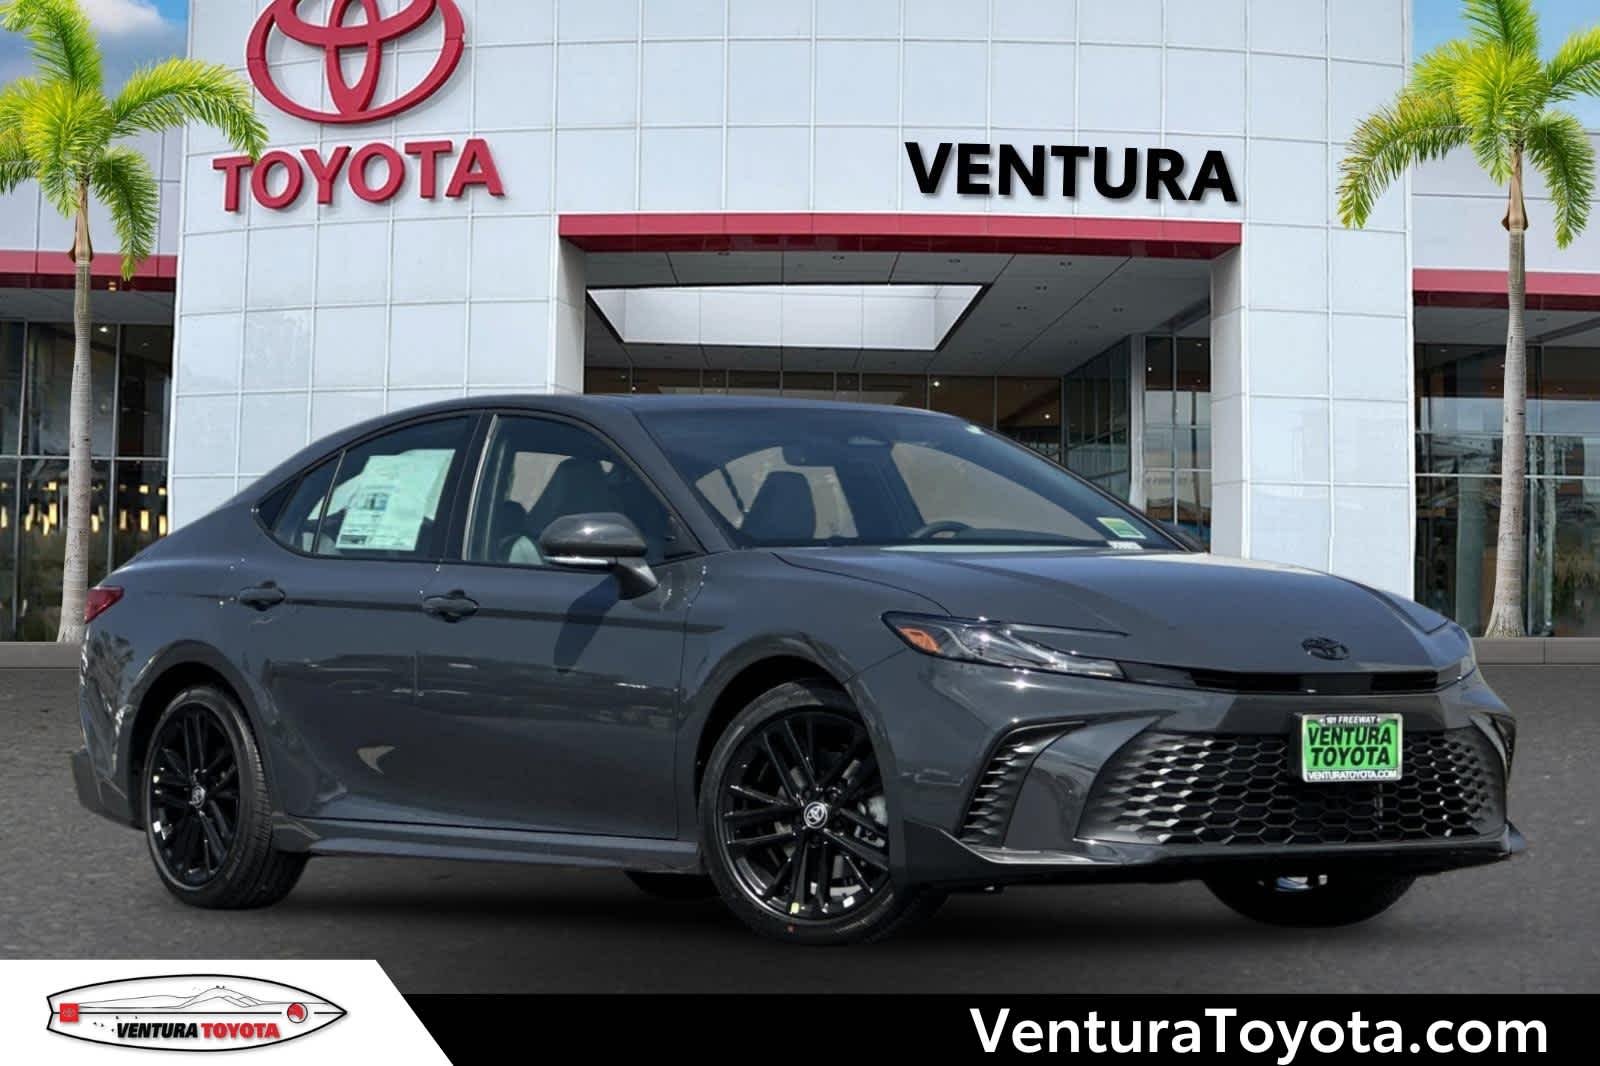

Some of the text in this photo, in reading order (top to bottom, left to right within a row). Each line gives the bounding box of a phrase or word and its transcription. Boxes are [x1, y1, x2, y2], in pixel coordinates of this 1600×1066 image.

[212, 138, 505, 213] TOYOTA
[904, 141, 1239, 203] VENTURA
[1339, 716, 1378, 724] FREEWAY
[1308, 726, 1392, 746] VENTURA
[1311, 746, 1391, 767] TOYOTA
[1307, 770, 1398, 780] VENTURATOYOTA.COM
